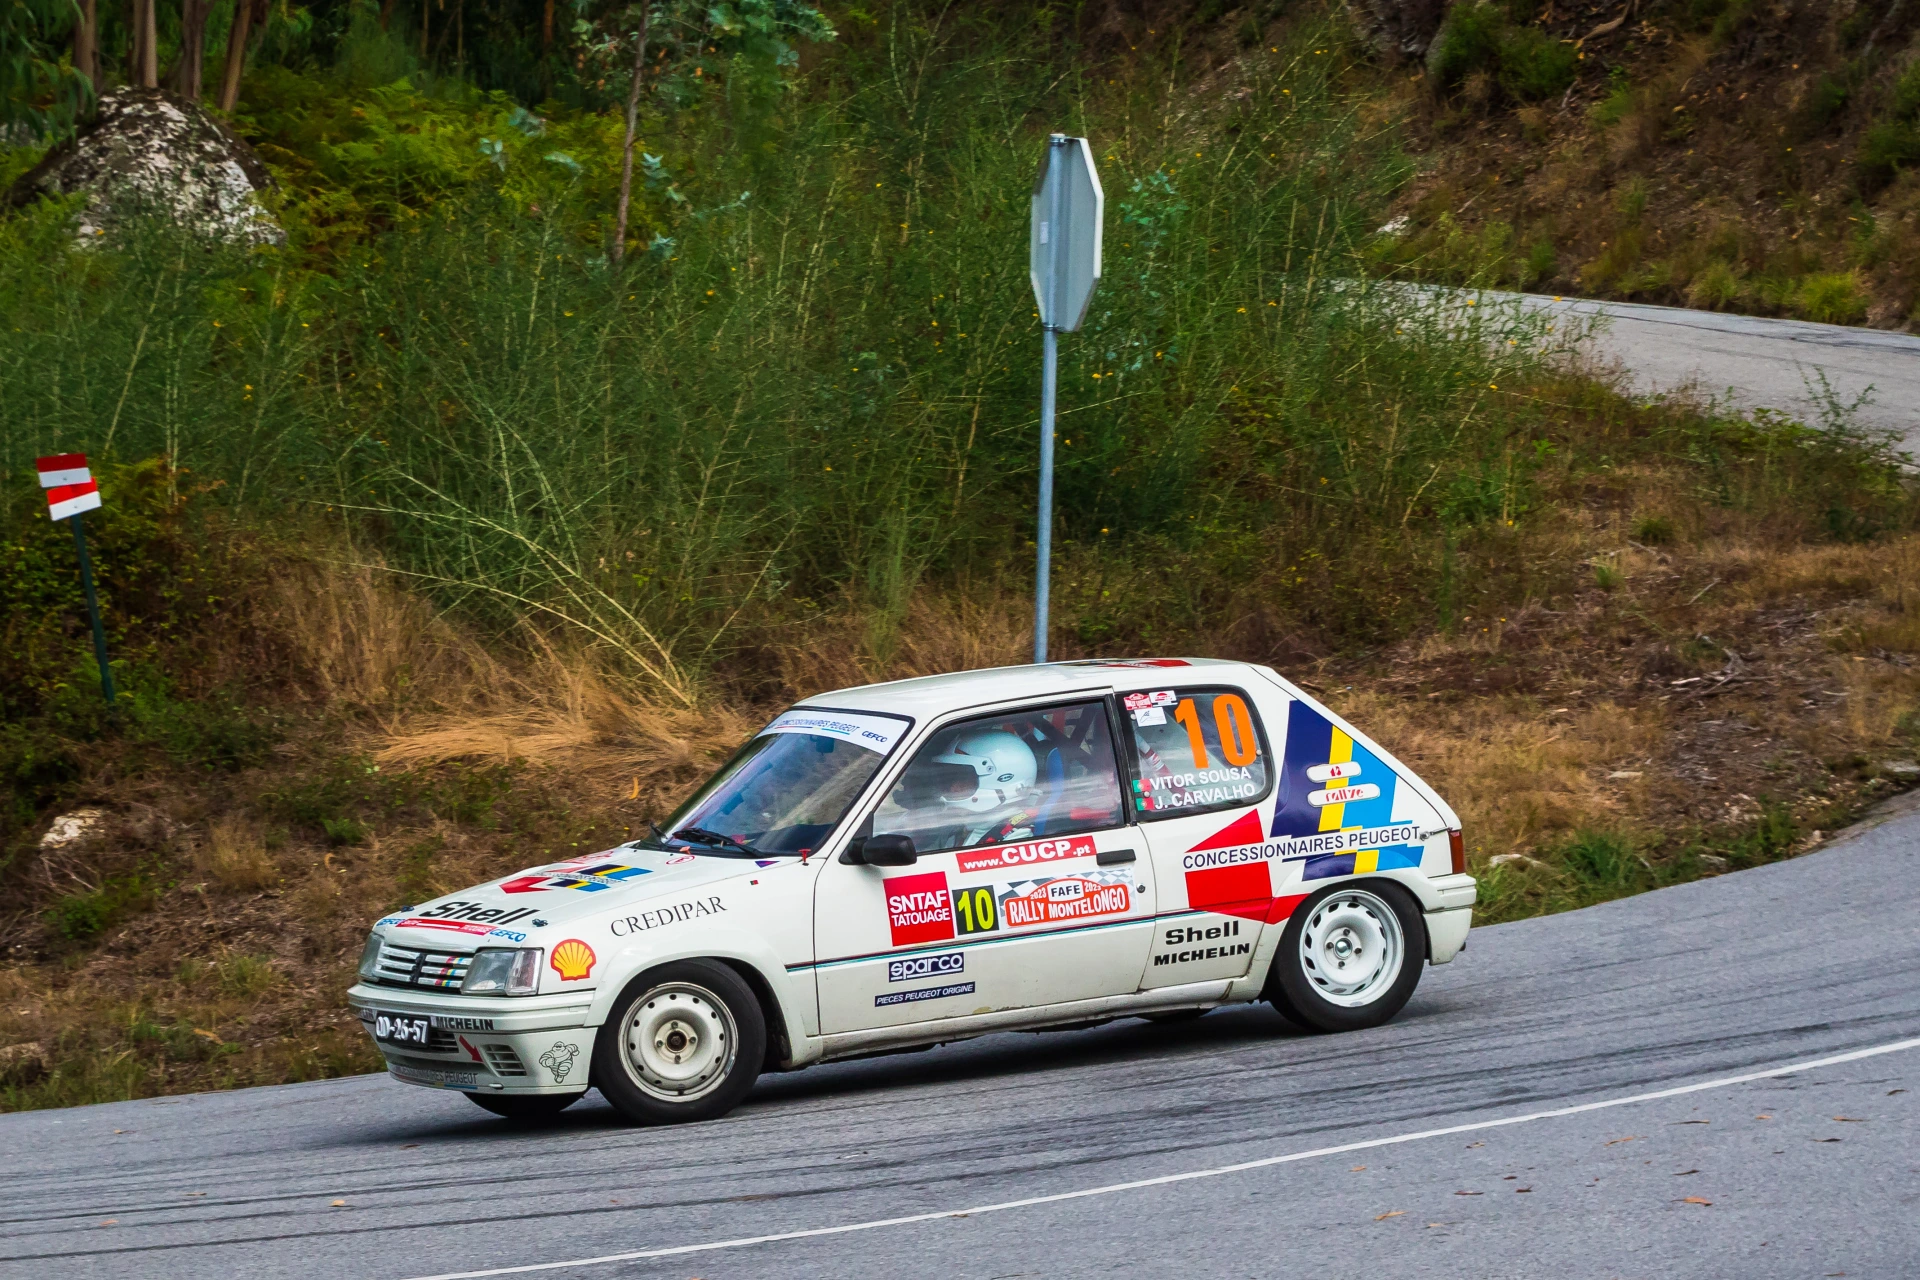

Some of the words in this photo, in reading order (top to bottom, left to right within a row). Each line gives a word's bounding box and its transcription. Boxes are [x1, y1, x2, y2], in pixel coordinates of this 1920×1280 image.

[861, 730, 888, 743] GEFCO
[1174, 693, 1257, 769] 10
[1149, 772, 1194, 791] VITOR
[1199, 767, 1252, 784] SOUSA
[1154, 793, 1168, 810] J.
[1172, 784, 1256, 807] CARVALHO
[964, 840, 1090, 869] www.CUCP.pt
[1183, 831, 1344, 869] CONCESSIONNAIRES
[1349, 826, 1420, 848] PEUGEOT
[889, 889, 947, 913] SNTAF
[1050, 884, 1081, 897] FAFE
[419, 901, 540, 925] Shell
[610, 896, 728, 937] CREDIPAR
[891, 907, 950, 926] TATOUAGE
[957, 888, 995, 932] 10
[1009, 900, 1045, 924] RALLY
[1048, 887, 1126, 919] MONTELONGO
[490, 929, 526, 942] GEFCO
[1165, 921, 1239, 945] Shell
[1154, 943, 1250, 966] MICHELIN
[890, 954, 963, 980] sparco
[877, 993, 903, 1005] PIECES
[904, 989, 941, 1001] PEUGEOT
[942, 984, 974, 996] ORIGINE
[436, 1016, 494, 1031] MICHELIN
[444, 1071, 478, 1084] PEUGEOT
